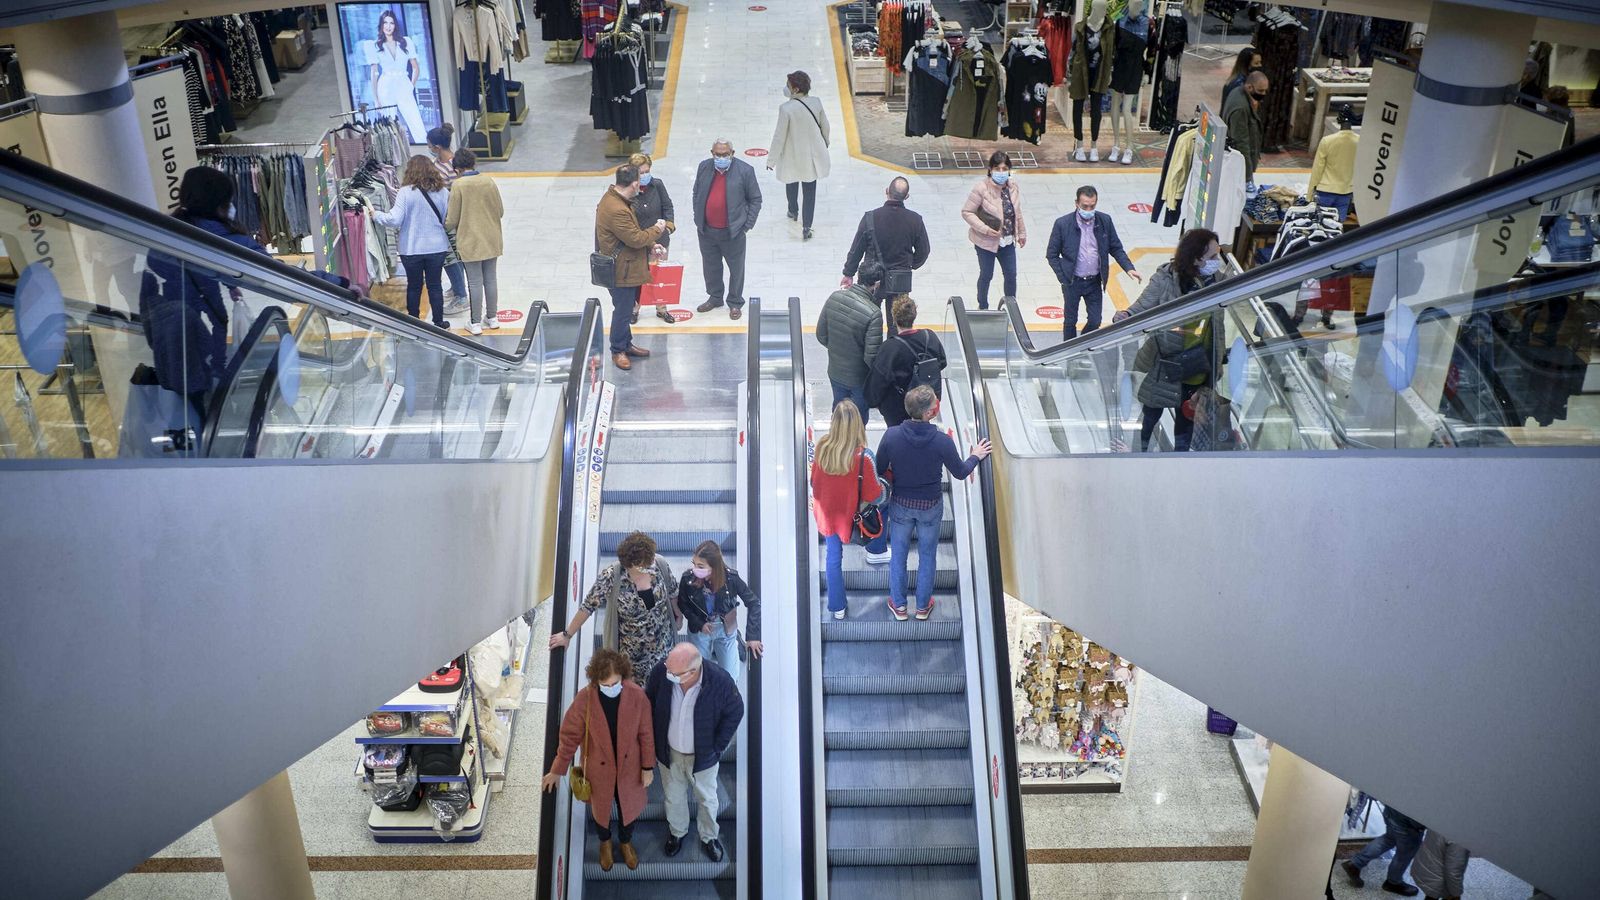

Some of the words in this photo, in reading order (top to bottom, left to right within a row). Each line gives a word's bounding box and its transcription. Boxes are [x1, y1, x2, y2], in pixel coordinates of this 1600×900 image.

[151, 96, 171, 141] Ella
[1367, 132, 1393, 200] Joven
[1381, 101, 1399, 125] El
[1492, 214, 1515, 255] Jov
